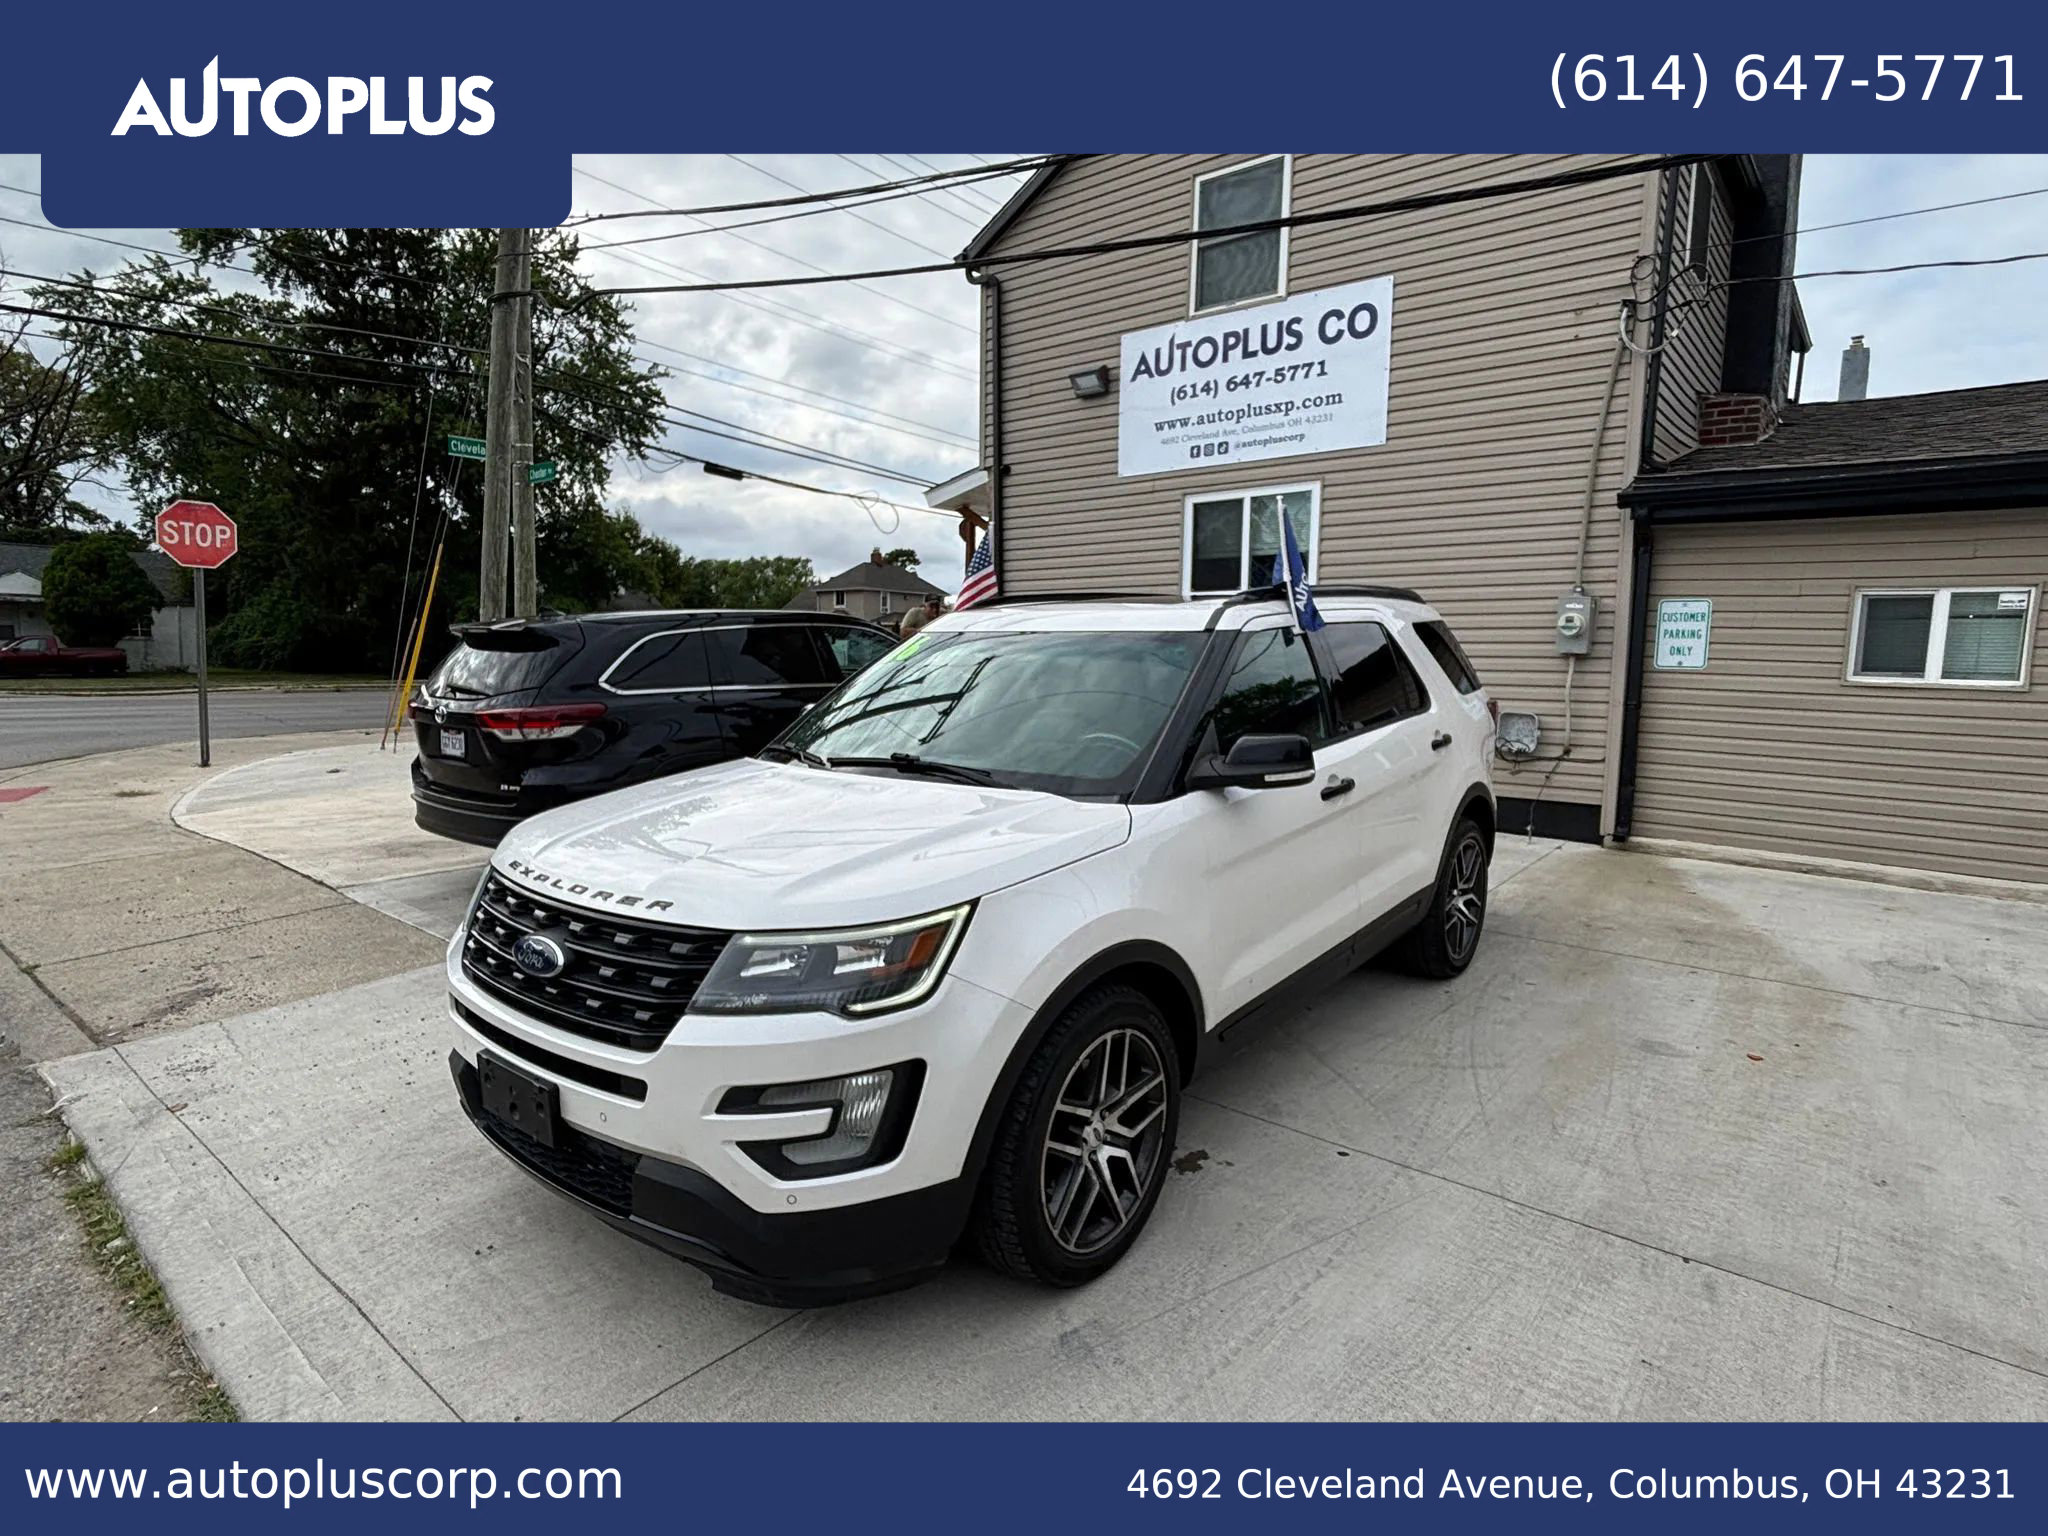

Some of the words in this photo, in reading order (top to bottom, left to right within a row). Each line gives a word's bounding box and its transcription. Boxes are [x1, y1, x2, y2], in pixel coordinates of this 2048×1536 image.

[1130, 317, 1304, 383] AUTOPLUS
[1318, 302, 1379, 346] CO
[1170, 378, 1219, 406] (614)
[1226, 360, 1329, 393] 647-5771
[1154, 392, 1344, 433] www.autoplusxp.com
[1242, 420, 1286, 435] Columbus
[1287, 417, 1303, 428] OH
[1305, 413, 1334, 425] 43231
[451, 440, 486, 456] Clevela
[1233, 431, 1306, 450] @autopluscorp
[162, 520, 231, 548] STOP
[1662, 611, 1707, 623] CUSTOMER
[1663, 628, 1703, 640] PARKING
[1669, 645, 1694, 657] ONLY
[508, 859, 675, 912] EXPLORER
